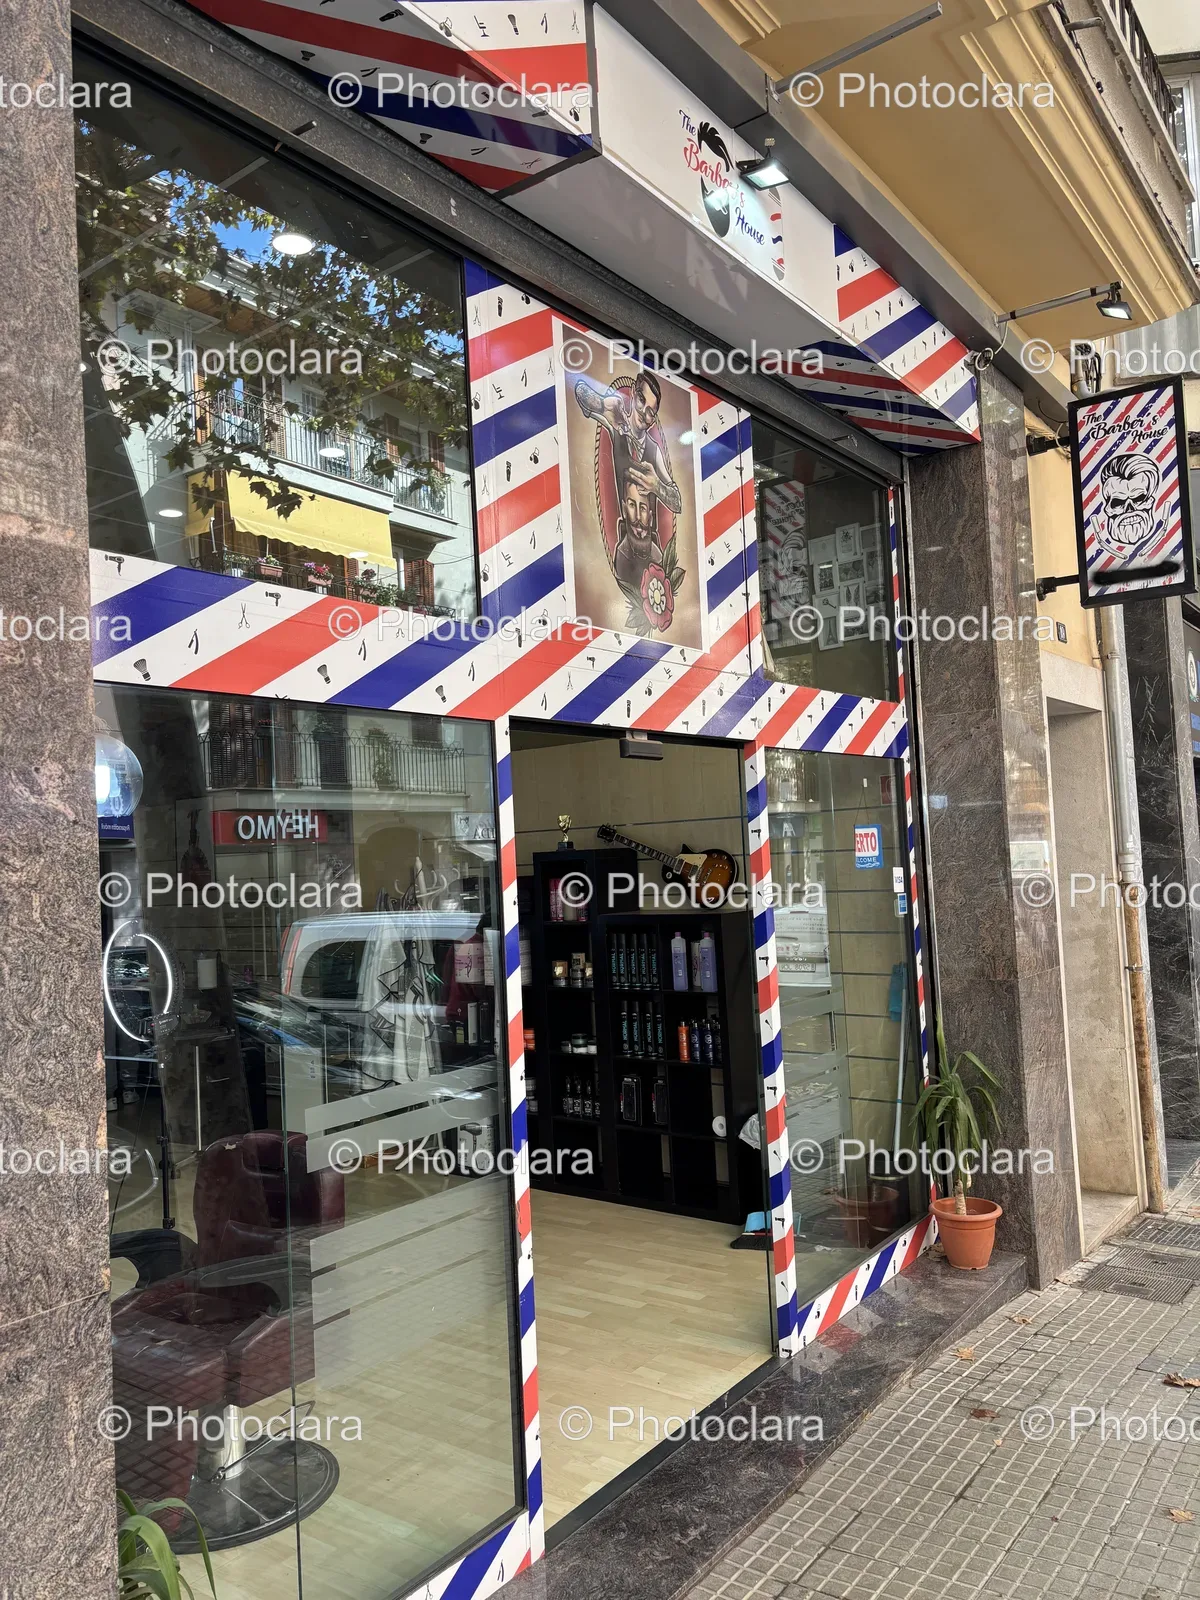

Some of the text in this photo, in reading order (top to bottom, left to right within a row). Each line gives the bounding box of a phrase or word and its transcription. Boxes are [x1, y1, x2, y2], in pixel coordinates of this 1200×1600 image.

[679, 109, 697, 137] The
[734, 206, 765, 246] House
[1082, 412, 1103, 426] The
[1130, 427, 1169, 444] House
